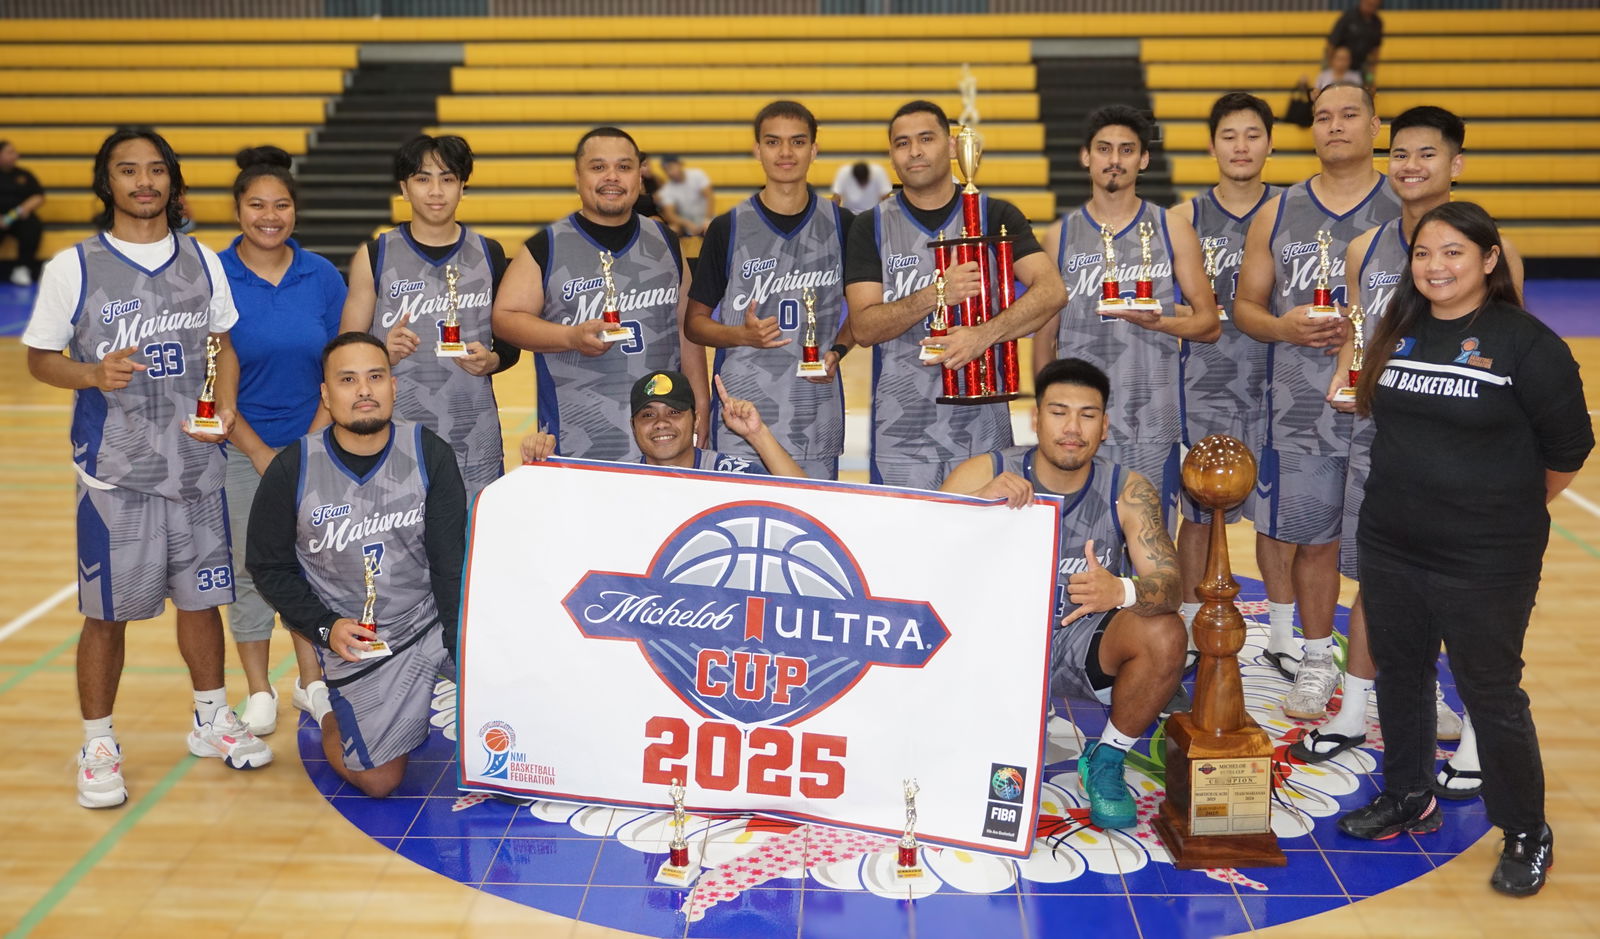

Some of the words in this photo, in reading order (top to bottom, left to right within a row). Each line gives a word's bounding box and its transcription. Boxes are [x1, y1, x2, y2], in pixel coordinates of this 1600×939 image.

[887, 254, 919, 274] Team
[1067, 253, 1103, 273] Team
[1282, 242, 1320, 264] Team
[742, 258, 777, 279] Team
[1368, 271, 1401, 290] Team
[390, 279, 425, 299] Team
[562, 277, 605, 301] Team
[733, 264, 840, 311] Marianas
[101, 299, 141, 325] Team
[562, 283, 679, 326] Mriana
[779, 299, 799, 331] 0
[96, 307, 209, 361] Marianas
[144, 341, 186, 379] 33
[1397, 372, 1479, 397] BASKETBALL
[308, 502, 426, 553] Marianas
[312, 504, 352, 526] Team
[362, 542, 385, 577] 7
[197, 565, 232, 592] 33
[584, 591, 740, 631] Michelob
[775, 606, 925, 650] ULTRA
[695, 648, 809, 705] CUP
[510, 752, 527, 763] NMI
[510, 763, 556, 777] BASKETBALL
[642, 716, 848, 800] 2025
[510, 773, 556, 786] FEDERATION
[991, 806, 1017, 823] FIBA
